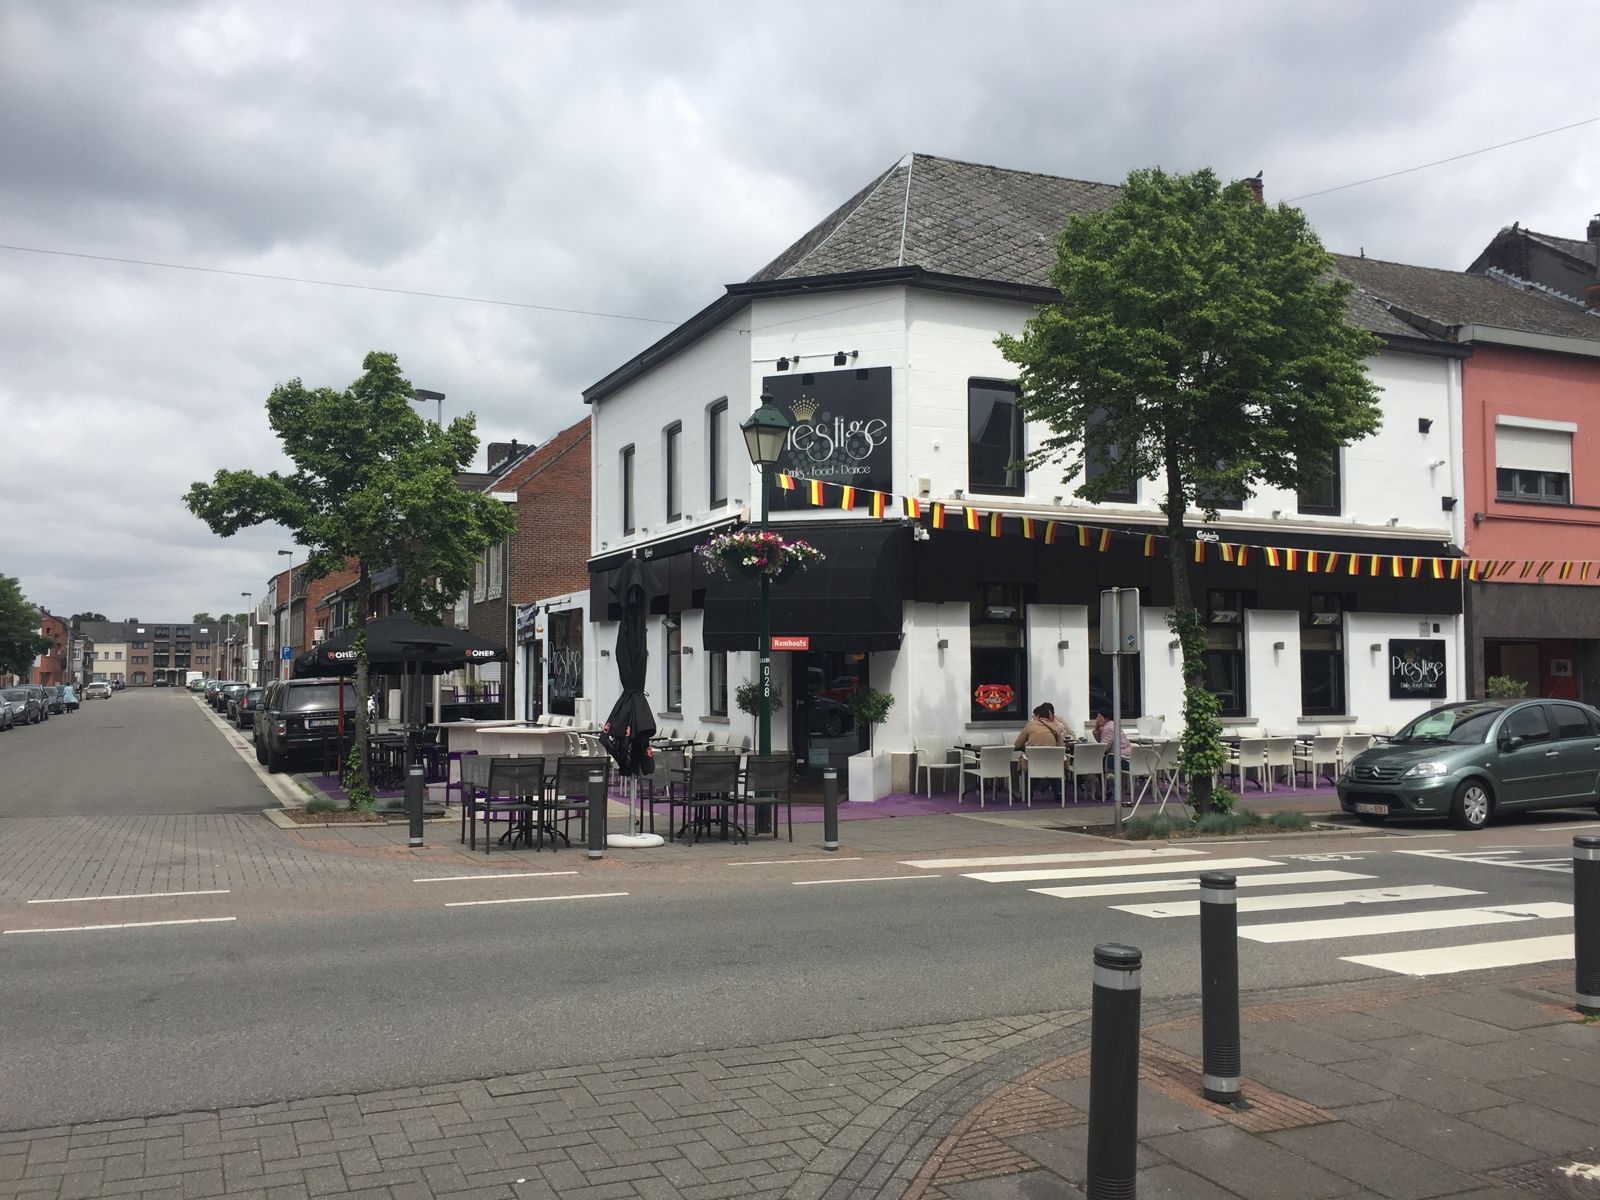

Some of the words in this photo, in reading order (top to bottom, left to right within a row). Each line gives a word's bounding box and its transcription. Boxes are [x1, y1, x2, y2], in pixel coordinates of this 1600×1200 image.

[787, 416, 888, 462] restige
[841, 464, 871, 475] Dance
[1392, 656, 1444, 682] Prestige
